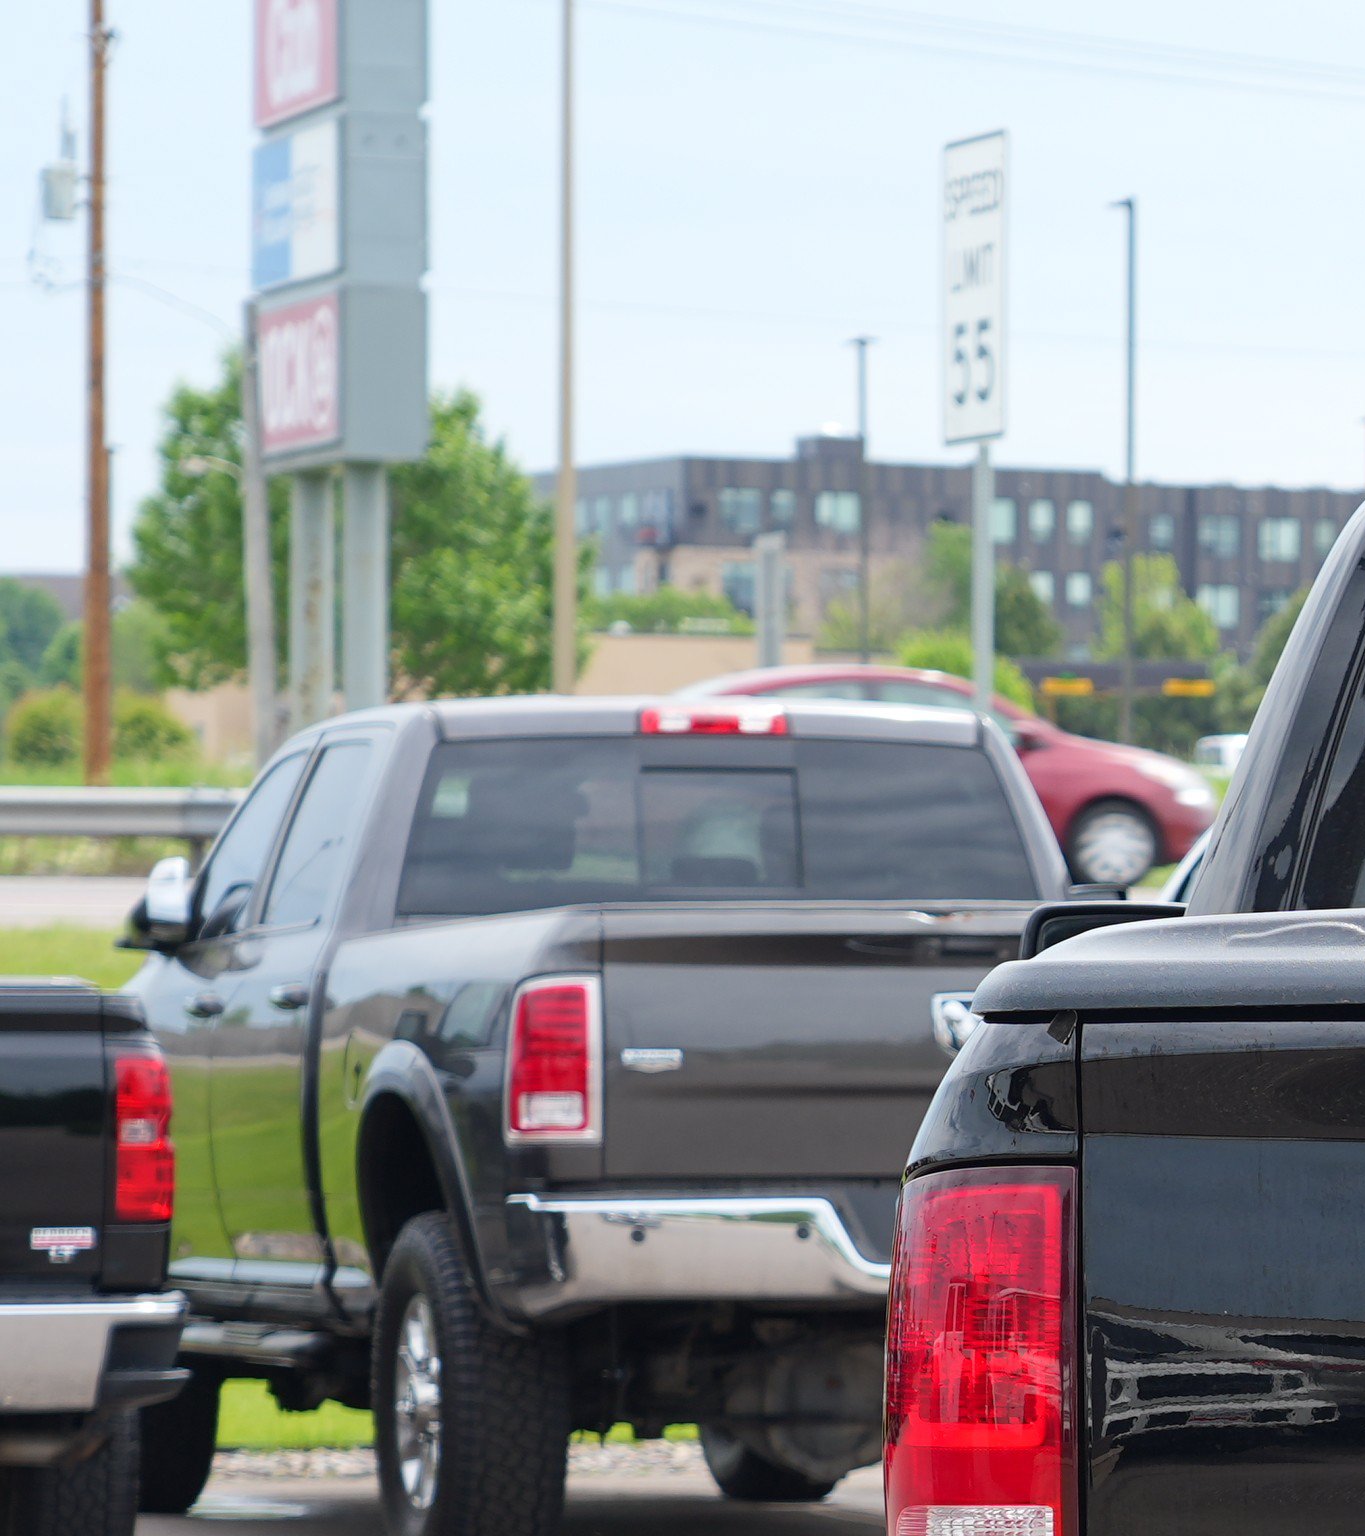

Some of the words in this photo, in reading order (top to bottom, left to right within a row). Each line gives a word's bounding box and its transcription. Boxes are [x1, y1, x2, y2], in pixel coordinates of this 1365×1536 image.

[945, 169, 1002, 222] SPEED
[949, 243, 994, 293] LIMIT
[953, 318, 995, 405] 55
